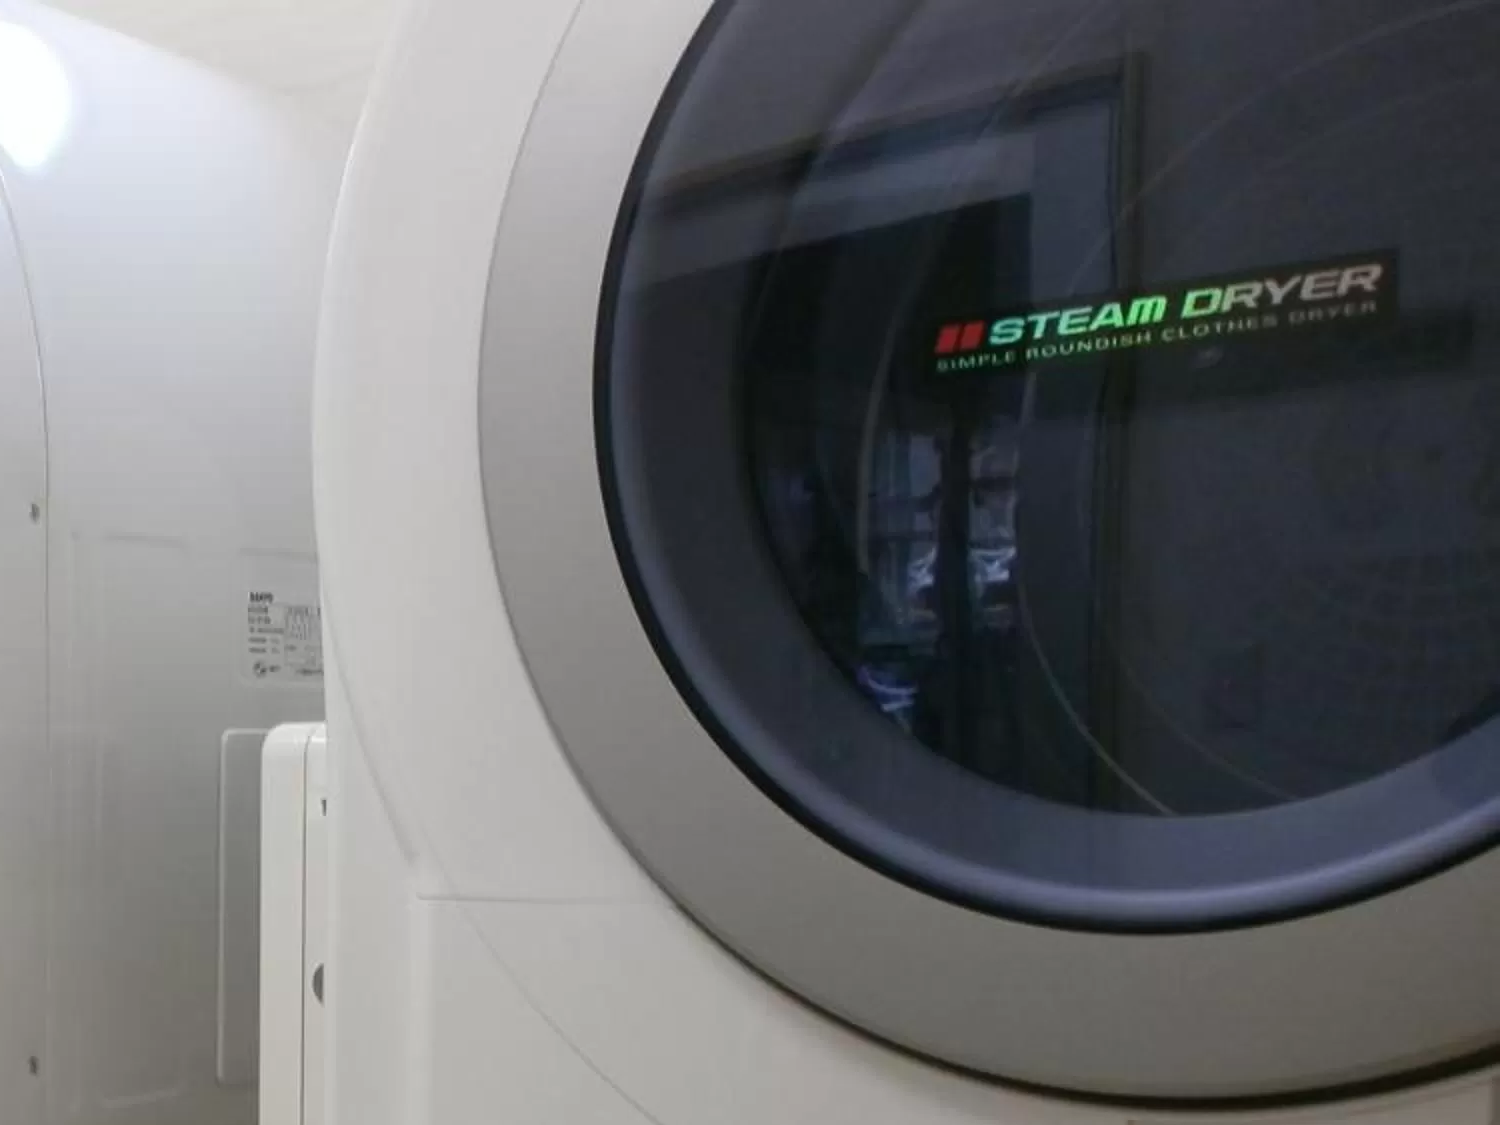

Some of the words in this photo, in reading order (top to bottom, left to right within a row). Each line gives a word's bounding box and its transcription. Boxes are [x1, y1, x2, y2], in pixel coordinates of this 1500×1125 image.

[936, 350, 1017, 374] SIMPLE
[1026, 330, 1154, 359] ROUNDISH
[1161, 317, 1279, 343] CLOTHES
[1288, 300, 1379, 325] DRYER
[988, 294, 1168, 346] STEAM
[1181, 262, 1385, 320] DRYER
